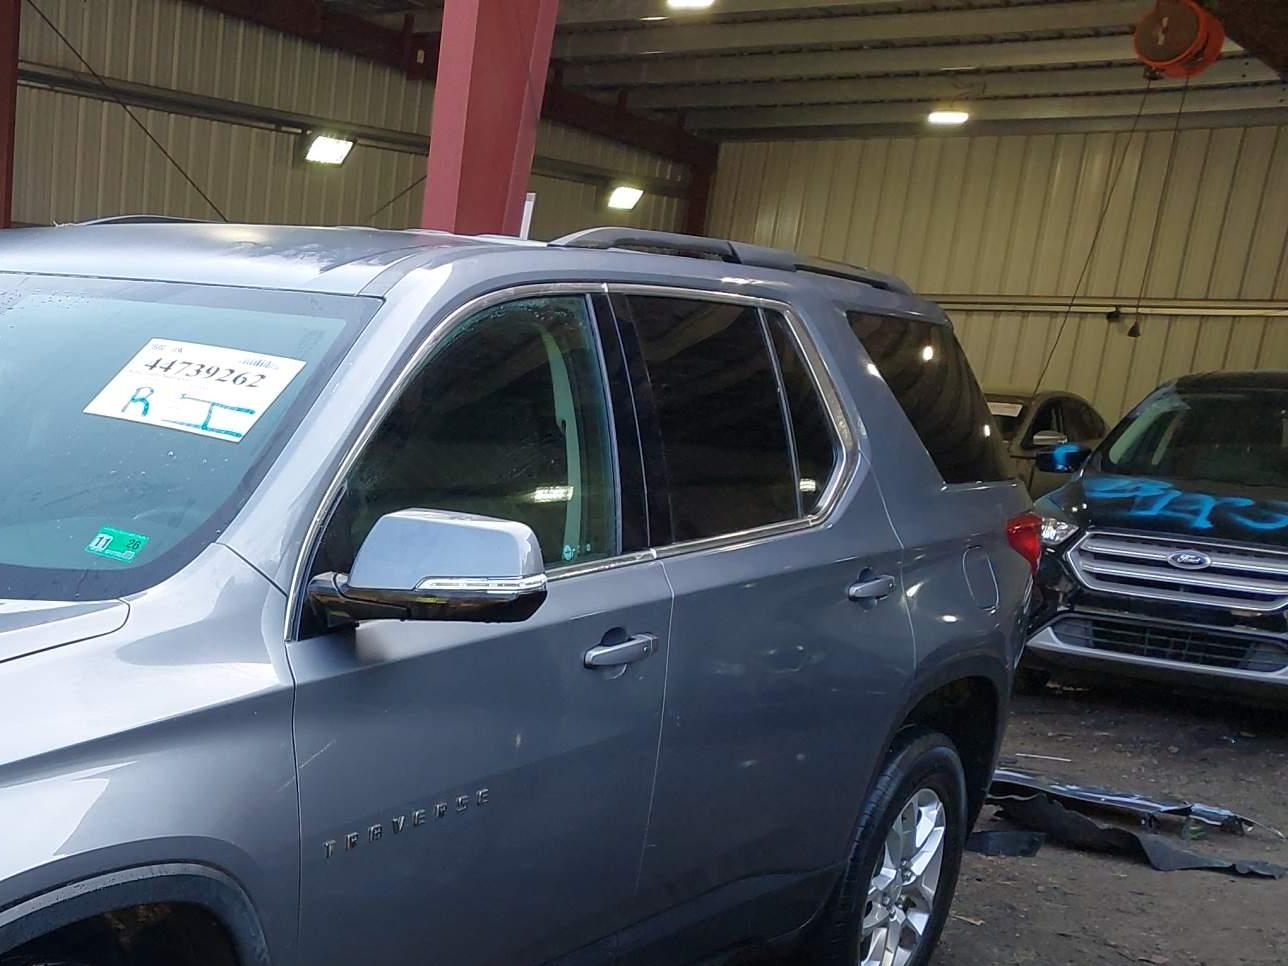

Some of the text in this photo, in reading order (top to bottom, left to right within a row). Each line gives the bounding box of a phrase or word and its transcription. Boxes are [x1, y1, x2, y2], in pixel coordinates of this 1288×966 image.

[144, 357, 267, 388] 44739262
[94, 536, 142, 550] 11 26
[323, 788, 489, 858] TRAVERSE
